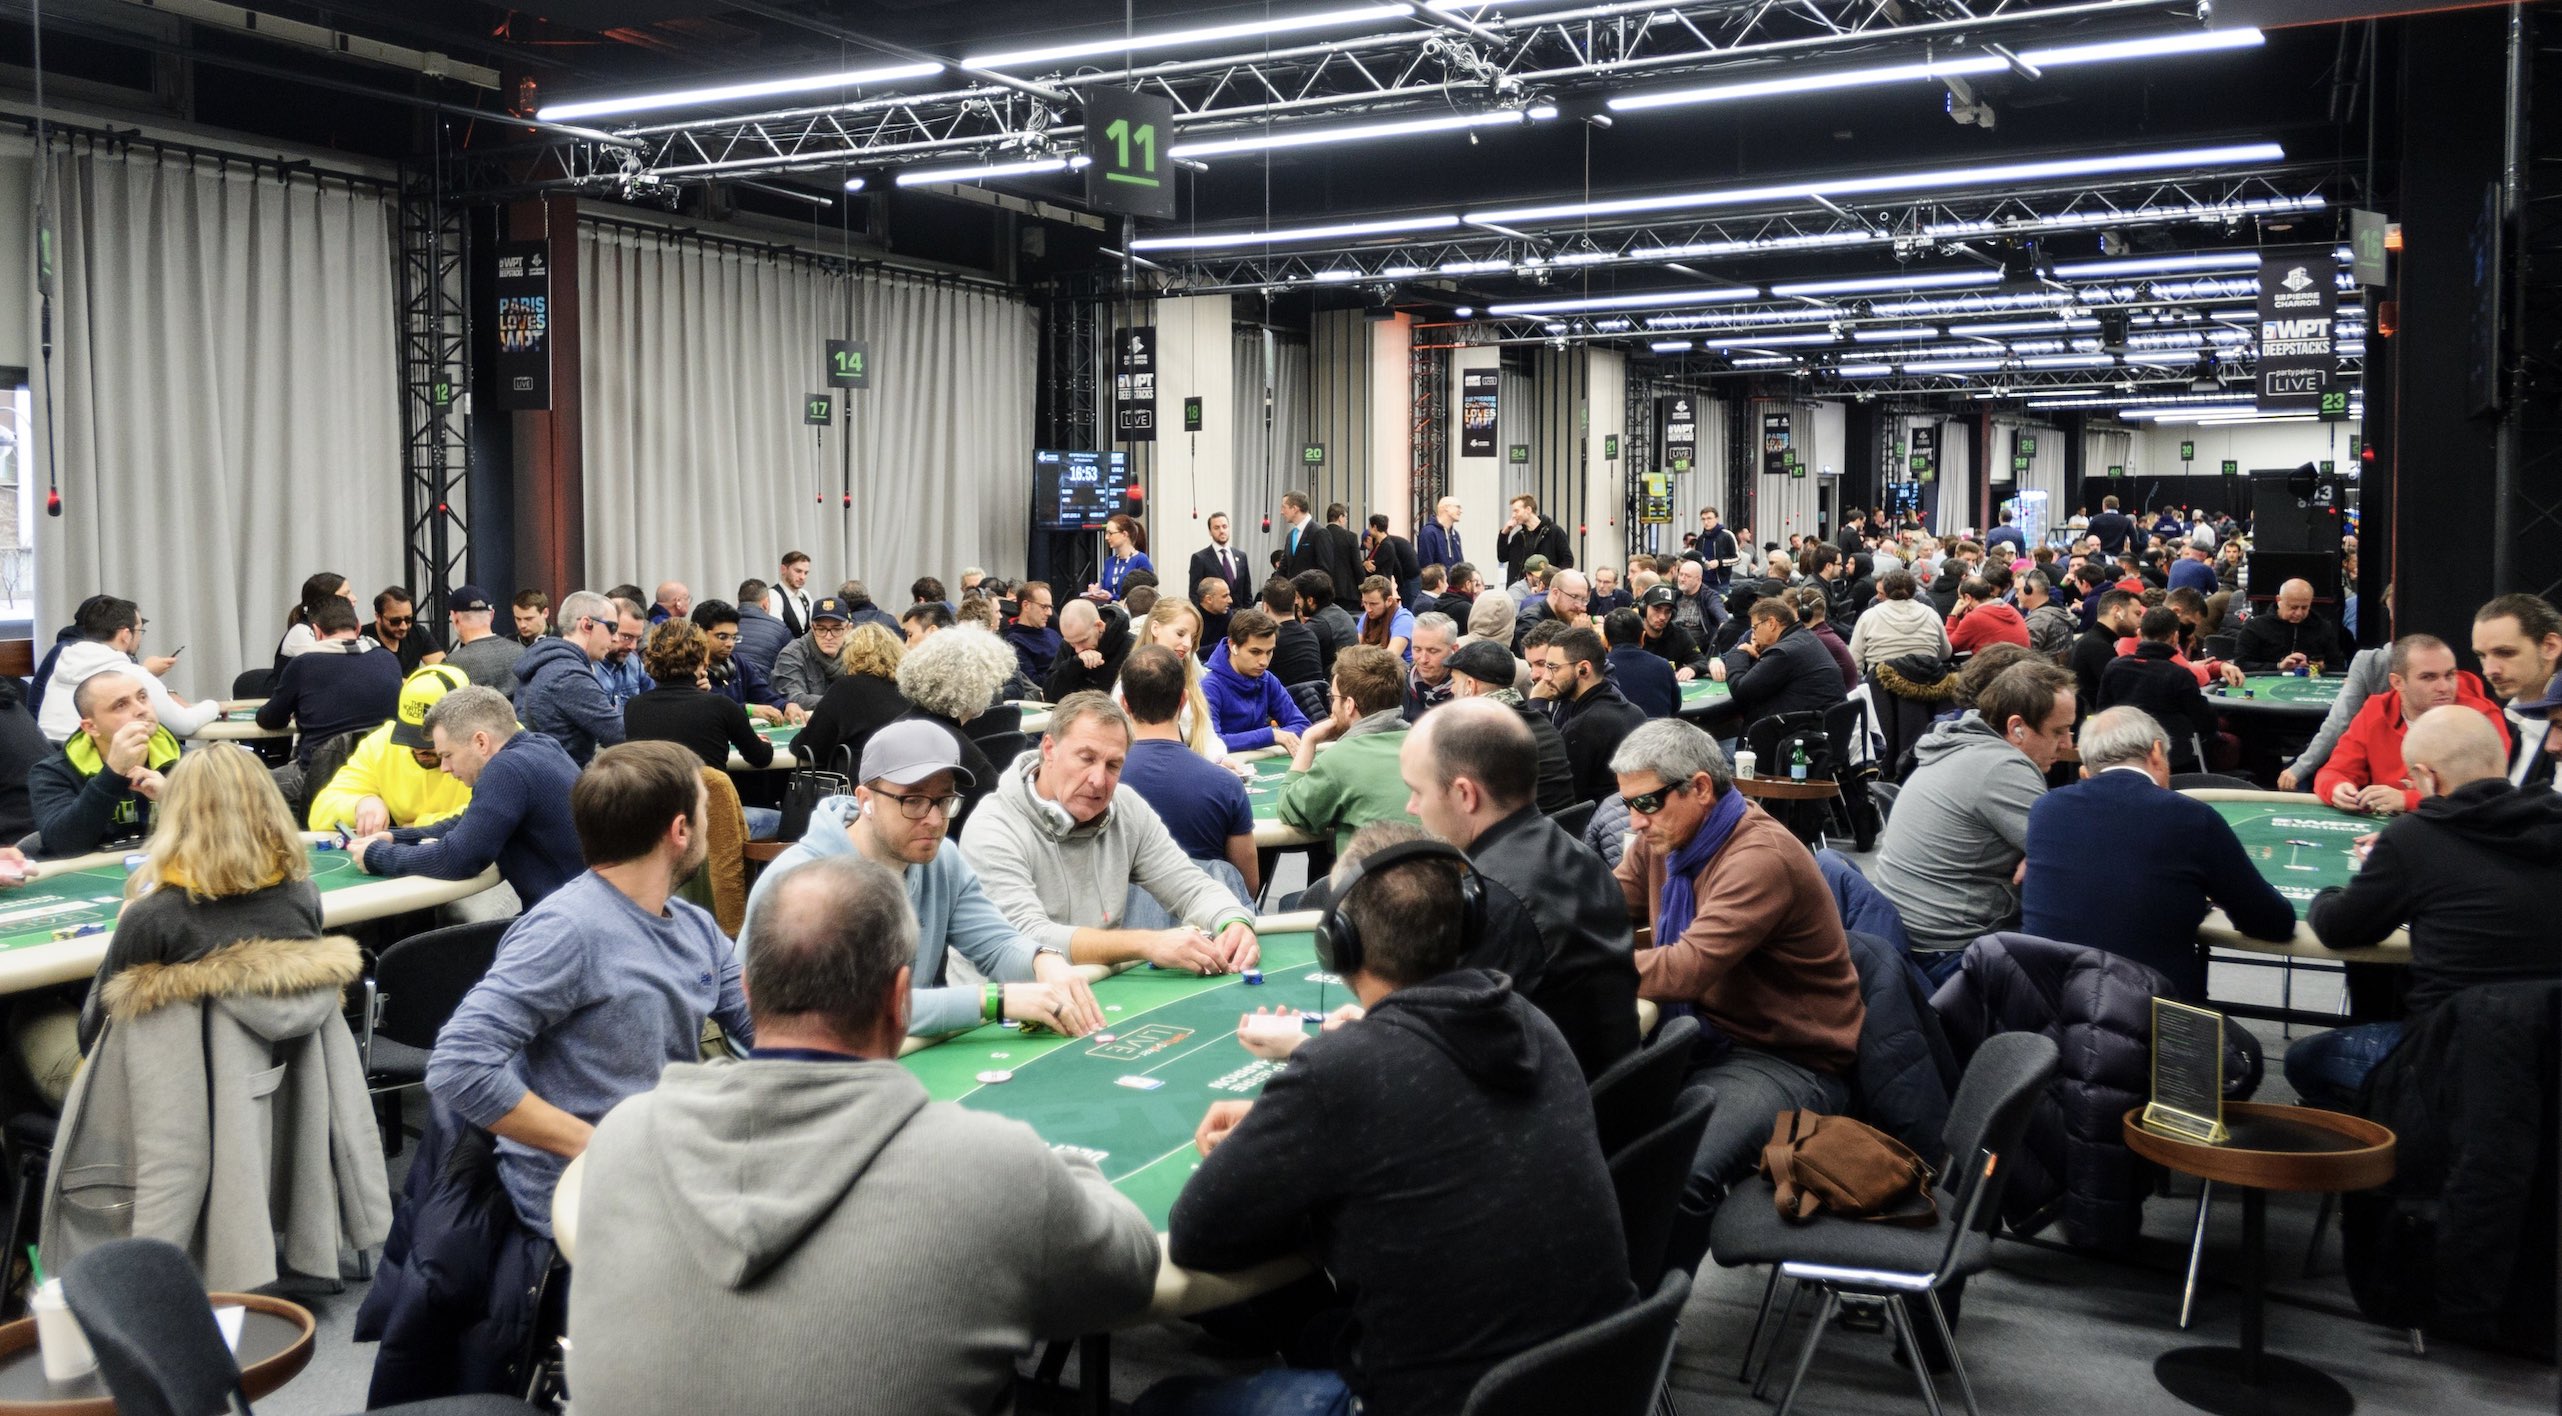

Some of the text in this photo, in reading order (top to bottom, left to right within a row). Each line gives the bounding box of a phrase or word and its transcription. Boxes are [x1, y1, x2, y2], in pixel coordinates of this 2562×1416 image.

[1105, 119, 1155, 172] 11
[2360, 229, 2381, 259] 16
[499, 296, 546, 314] PARIS
[2274, 300, 2321, 308] CHARRON
[499, 314, 546, 330] LOVES
[2277, 318, 2332, 339] WPT
[2261, 340, 2331, 357] DEEPSTACKS
[834, 351, 863, 372] 14
[2275, 367, 2317, 378] partypoker
[434, 383, 449, 401] 12
[2275, 376, 2317, 392] LIVE
[809, 401, 828, 415] 17
[2322, 392, 2346, 410] 23
[1186, 404, 1199, 420] 18
[1465, 408, 1497, 418] LOVES
[1125, 415, 1148, 426] LVE
[1305, 447, 1322, 459] 20
[1511, 448, 1526, 458] 24
[1606, 440, 1617, 452] 21
[2021, 439, 2035, 451] 26
[2182, 445, 2193, 456] 30
[1069, 465, 1098, 482] 16:53
[2109, 468, 2121, 476] 40
[2223, 463, 2236, 472] 33
[1104, 1028, 1174, 1056] LIVE
